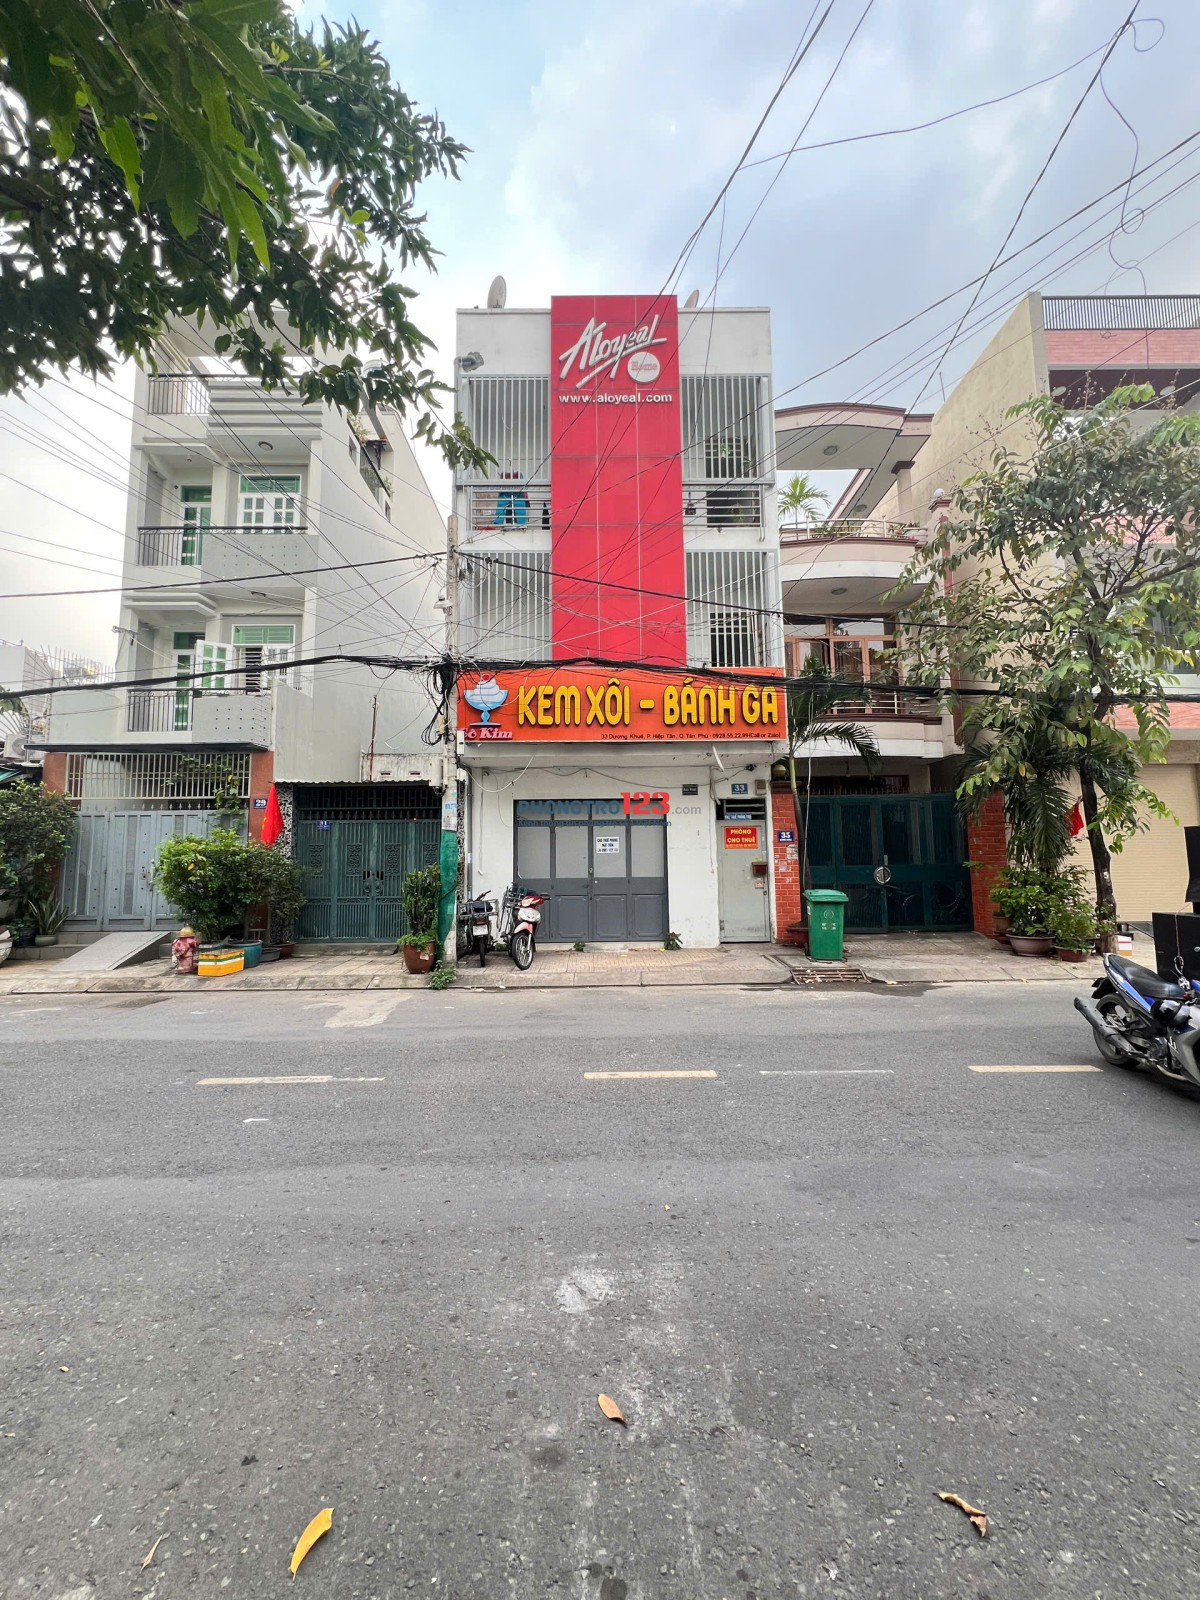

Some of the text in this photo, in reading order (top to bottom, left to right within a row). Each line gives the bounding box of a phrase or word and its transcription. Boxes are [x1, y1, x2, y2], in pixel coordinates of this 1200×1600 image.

[558, 392, 673, 405] www.aloyeal.com
[518, 677, 779, 726] KEM XÔI - BÁNH GA
[480, 727, 513, 738] Kim
